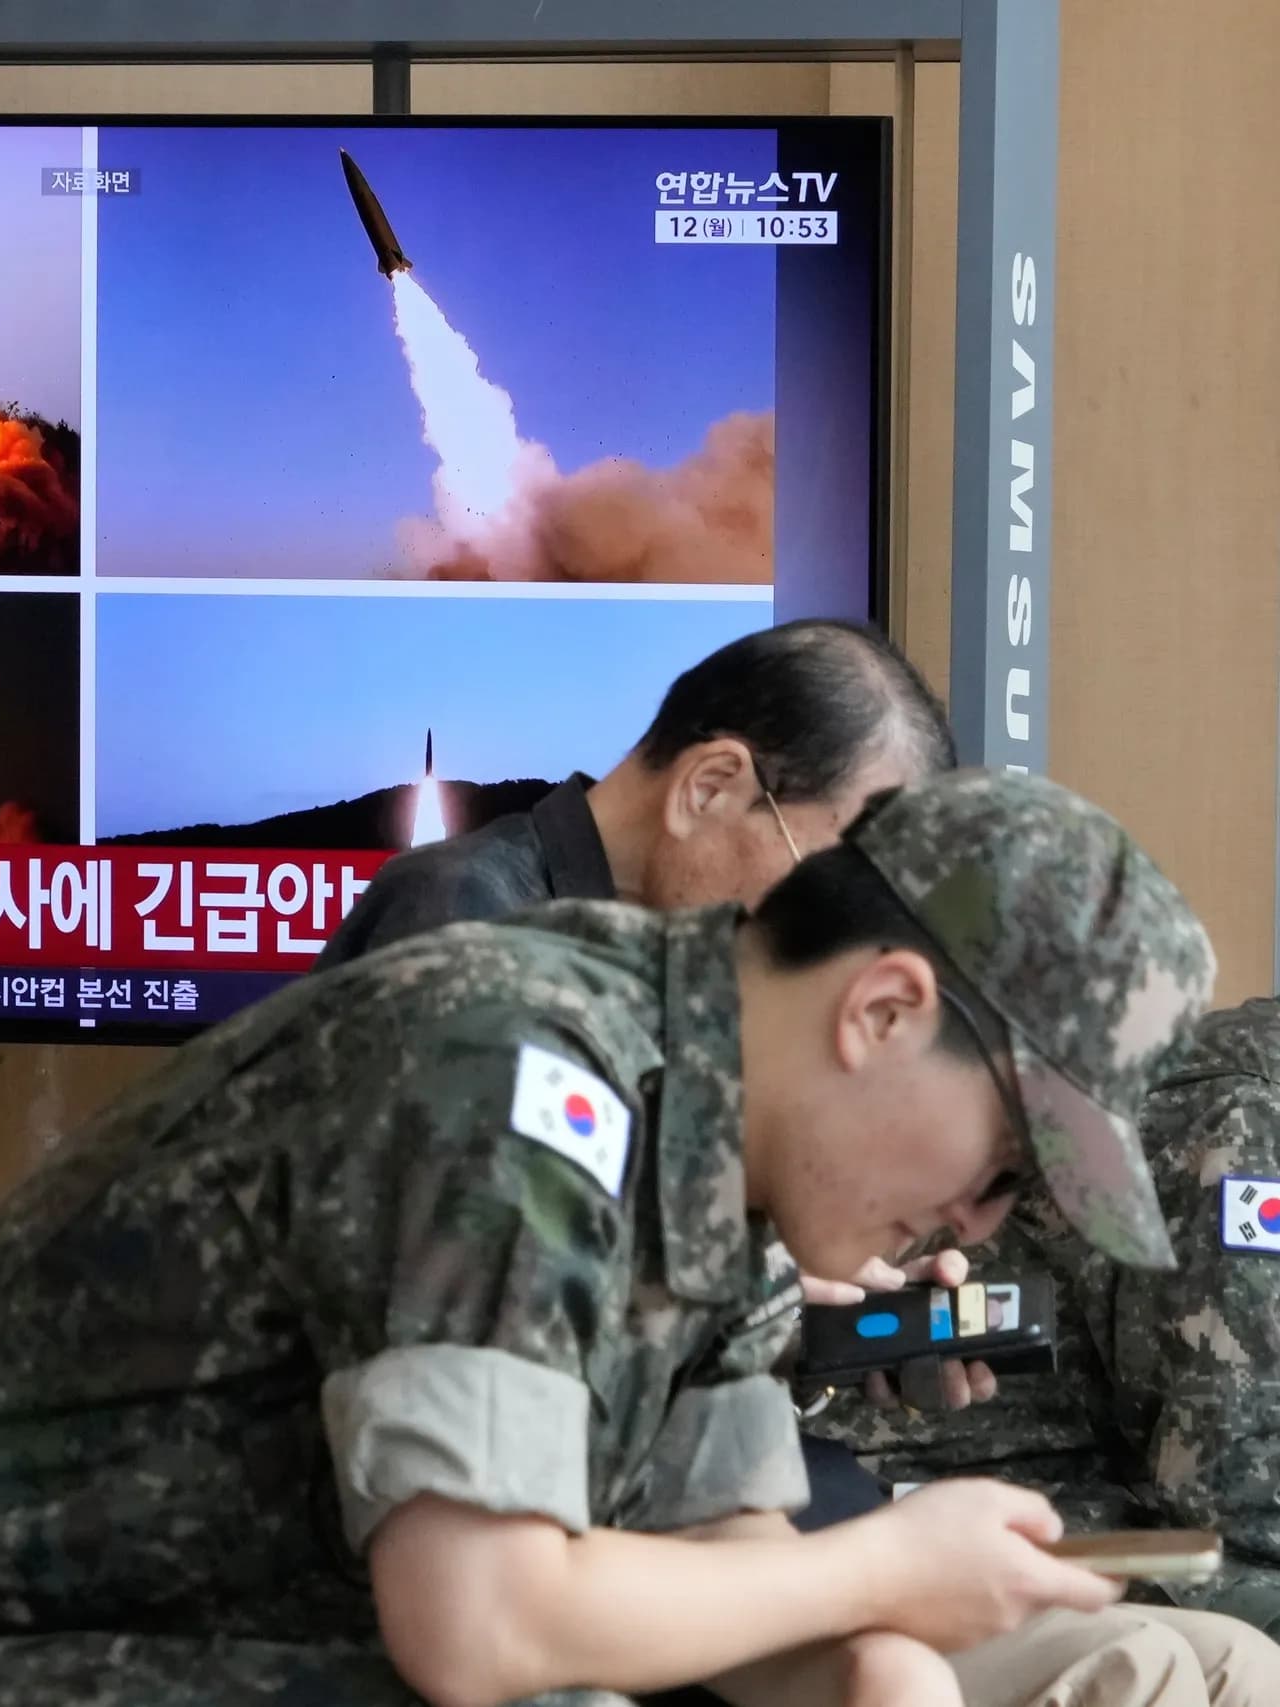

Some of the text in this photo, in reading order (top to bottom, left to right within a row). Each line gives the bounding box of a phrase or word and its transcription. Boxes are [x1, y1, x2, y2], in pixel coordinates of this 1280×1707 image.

[51, 171, 130, 193] 자료화면
[655, 171, 838, 205] 연합뉴스TV
[757, 217, 828, 238] 10:53
[1006, 252, 1036, 775] SAMSU
[76, 978, 132, 1009] 본선
[143, 979, 199, 1011] 진출
